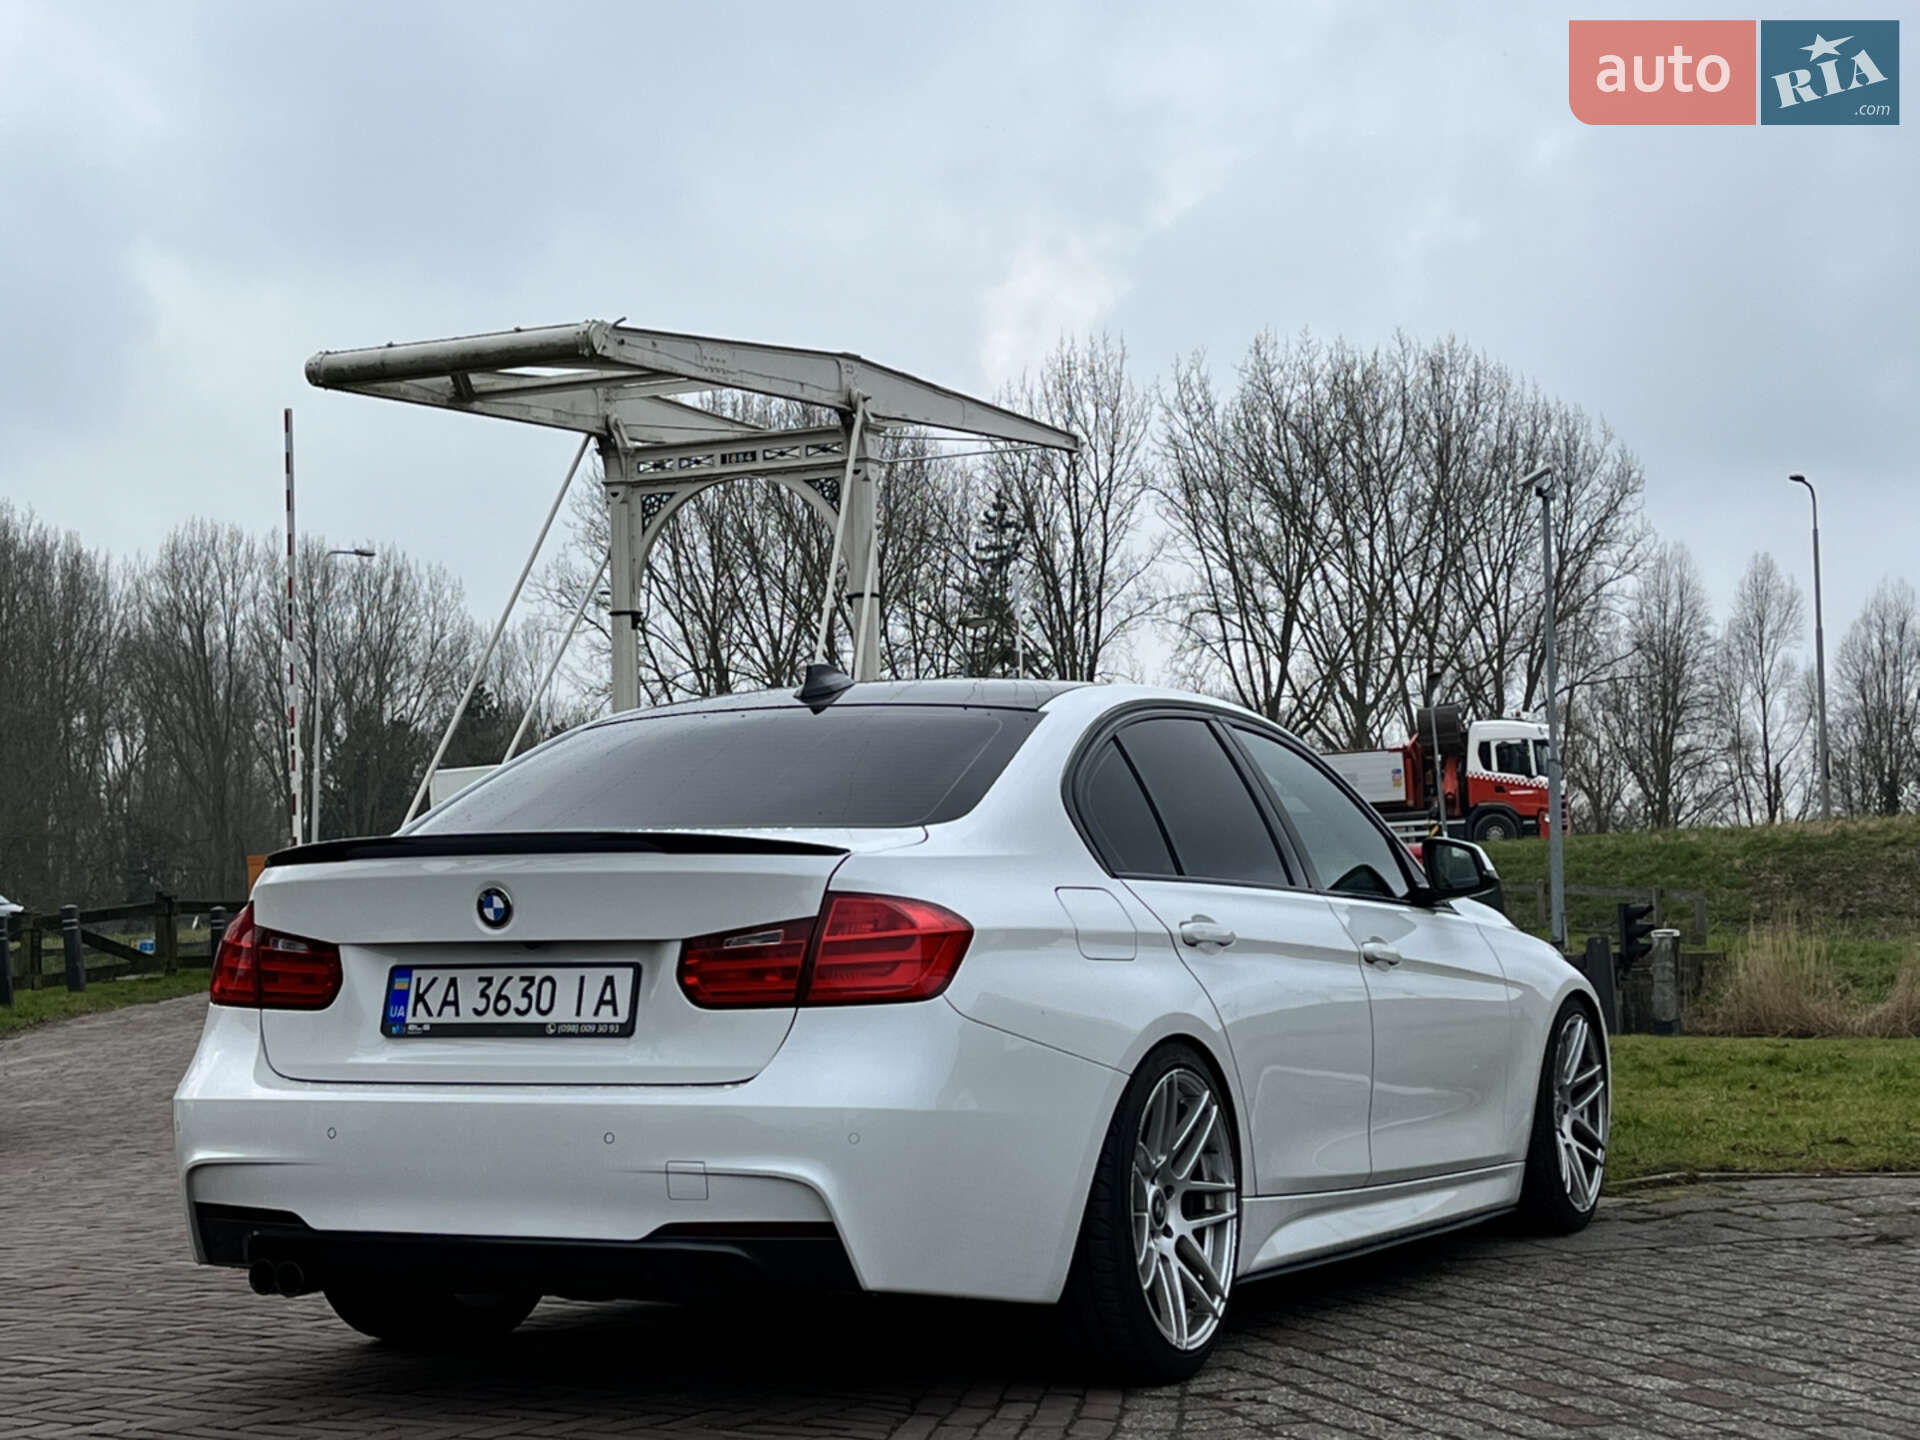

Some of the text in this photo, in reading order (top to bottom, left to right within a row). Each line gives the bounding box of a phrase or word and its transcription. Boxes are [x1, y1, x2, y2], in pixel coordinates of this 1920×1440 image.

[411, 975, 619, 1018] KA 3630 IA
[390, 1005, 405, 1018] UA
